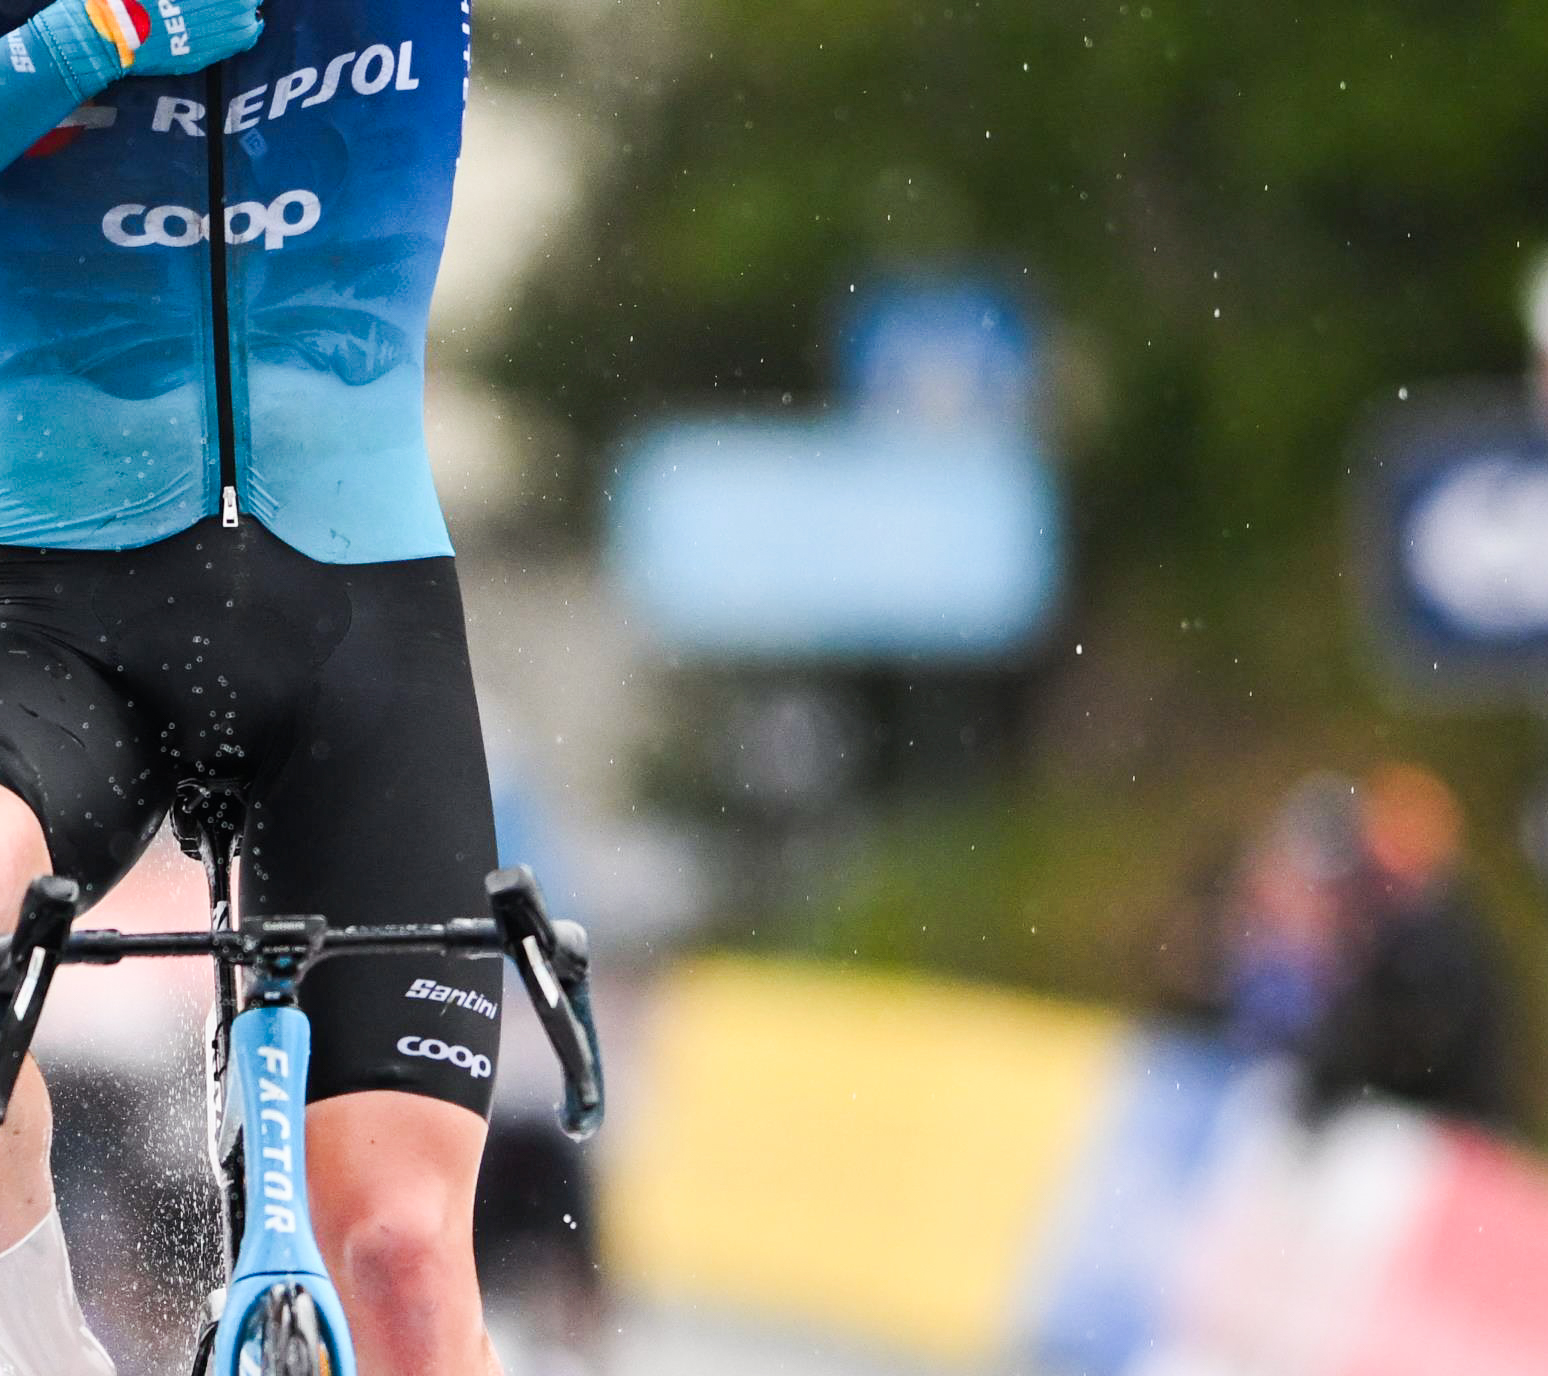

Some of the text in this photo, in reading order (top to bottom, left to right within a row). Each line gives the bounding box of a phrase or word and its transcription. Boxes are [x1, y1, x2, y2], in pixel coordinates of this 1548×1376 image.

[152, 40, 419, 137] REPSOL
[102, 189, 321, 251] coop
[405, 978, 498, 1020] Santini
[397, 1036, 492, 1079] coop
[258, 1045, 296, 1234] FACTOR
